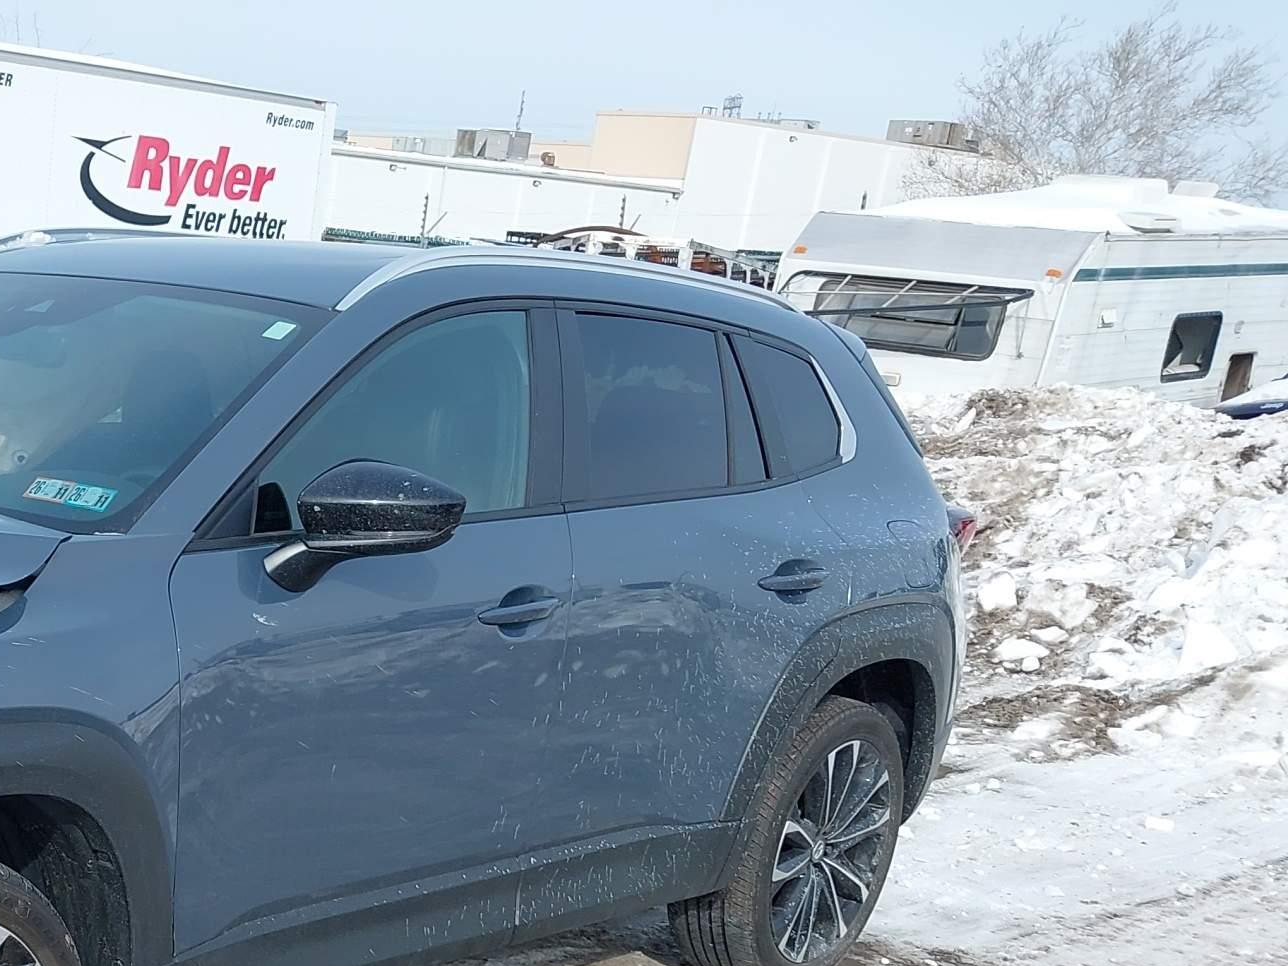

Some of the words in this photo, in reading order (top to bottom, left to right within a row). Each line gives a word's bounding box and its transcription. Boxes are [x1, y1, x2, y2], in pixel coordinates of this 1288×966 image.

[266, 112, 315, 131] Ryder.com
[127, 134, 276, 207] Ryder
[181, 203, 226, 233] Ever
[228, 208, 288, 240] better.
[29, 480, 46, 495] 26
[69, 487, 86, 502] 26
